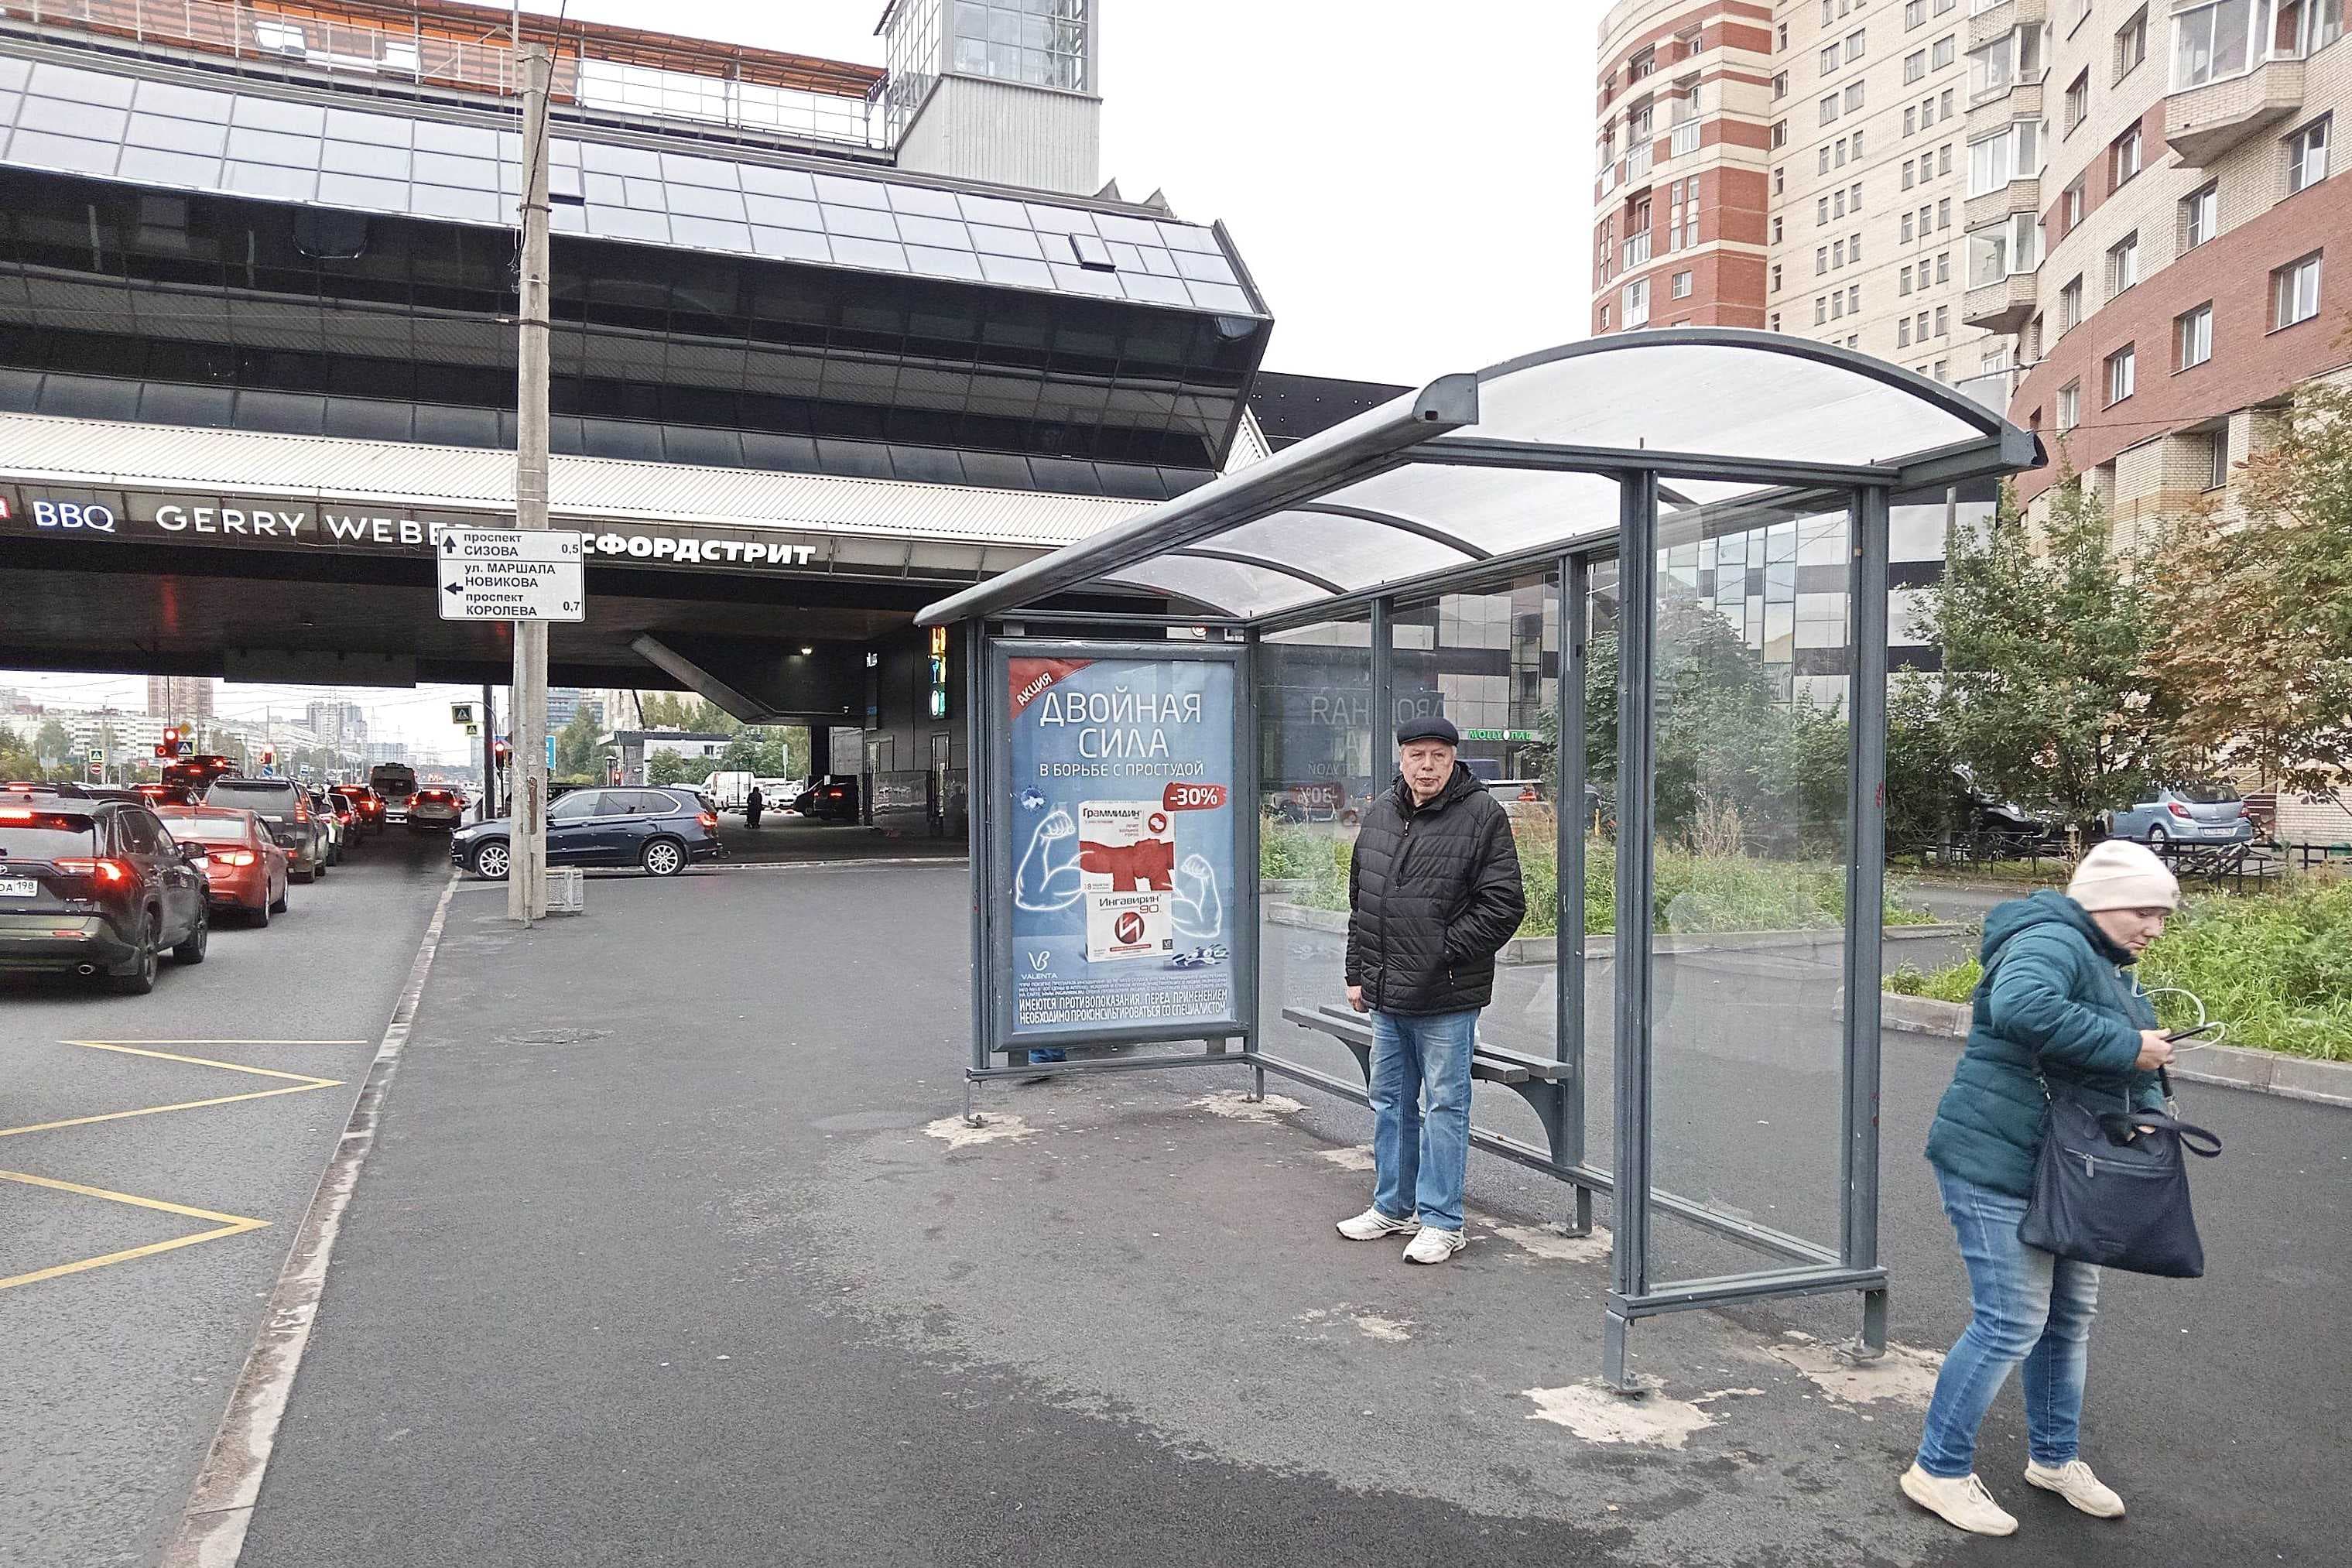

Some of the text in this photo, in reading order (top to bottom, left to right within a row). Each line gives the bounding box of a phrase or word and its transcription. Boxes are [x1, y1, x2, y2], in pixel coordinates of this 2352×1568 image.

[33, 501, 115, 532] BBQ
[155, 505, 440, 546] GERRY WEBE
[464, 533, 522, 543] проспект
[464, 544, 579, 556] СИЗОВА 0,5
[582, 532, 817, 566] СФОРДСТРИТ
[464, 563, 556, 575] ул. МАРШАЛА
[465, 576, 539, 587] НОВИКОВА
[465, 593, 524, 603] проспект
[466, 601, 580, 616] КОРОЛЕВА 0,7
[1016, 672, 1053, 707] АКЦИЯ
[1039, 685, 1201, 727] ДВОЙНАЯ
[1468, 729, 1501, 739] MOLLY
[1079, 728, 1169, 758] СИЛА
[1040, 760, 1204, 777] В БОРЬБЕ С ПРОСТУДОЙ
[1083, 808, 1140, 819] Граммидин
[16, 882, 34, 890] 198
[1099, 896, 1159, 907] Ингавирин
[1139, 904, 1159, 914] 90
[1019, 988, 1227, 1012] ИМЕЮТСЯ ПРОТИВОПОКАЗАНИЯ. ПЕРЕД ПРИМЕНЕНИЕМ
[1019, 1009, 1070, 1025] НЕОБХОДИМО
[1071, 1005, 1161, 1022] ПРОКОНСУЛЬТИРОВАТЬСЯ
[1162, 1004, 1171, 1016] СО
